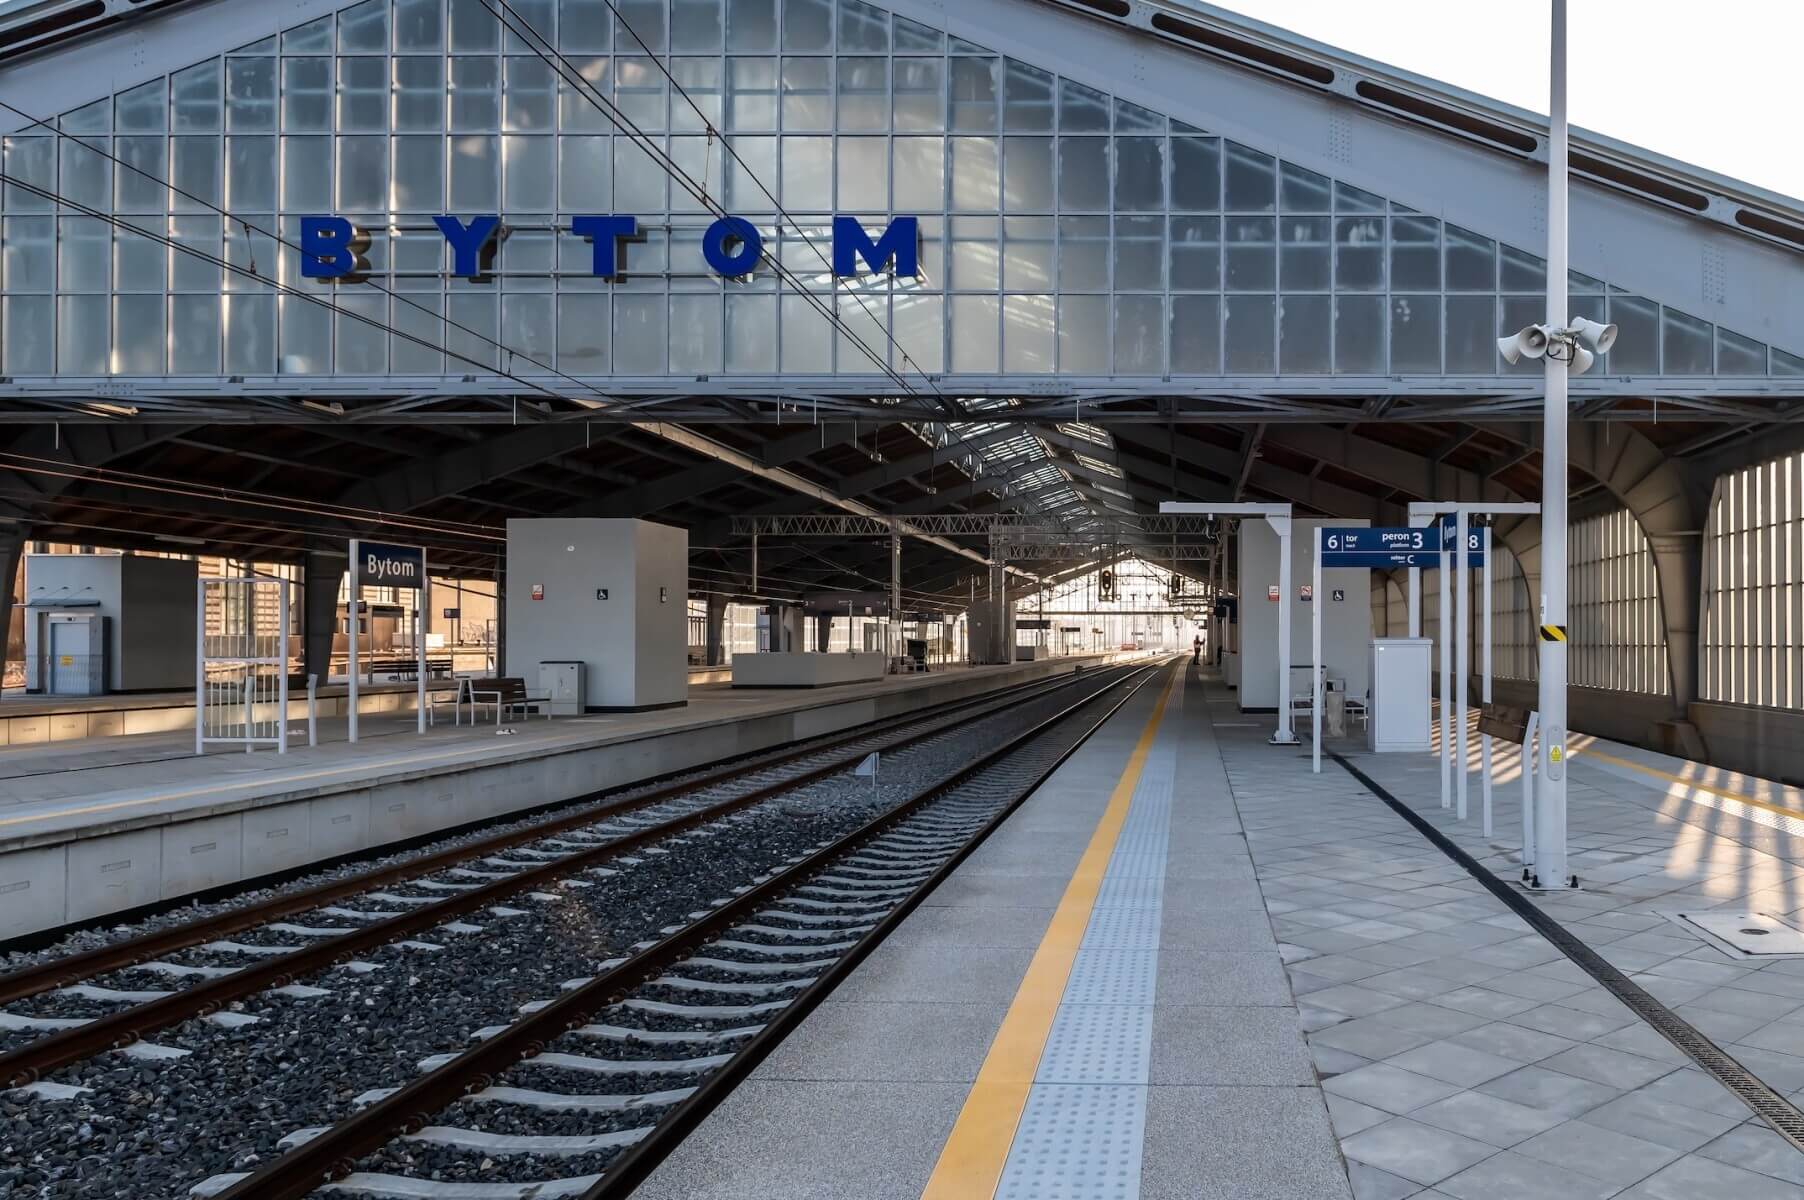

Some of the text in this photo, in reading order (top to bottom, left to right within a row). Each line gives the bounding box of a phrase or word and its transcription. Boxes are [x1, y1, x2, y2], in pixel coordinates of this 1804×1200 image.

[301, 216, 917, 278] BYTOM
[1327, 535, 1338, 549] 6
[1346, 534, 1358, 542] tor
[1382, 533, 1410, 543] peron
[1412, 532, 1423, 549] 3
[1468, 534, 1479, 549] 8
[367, 554, 414, 579] Bytom
[1407, 554, 1415, 564] C
